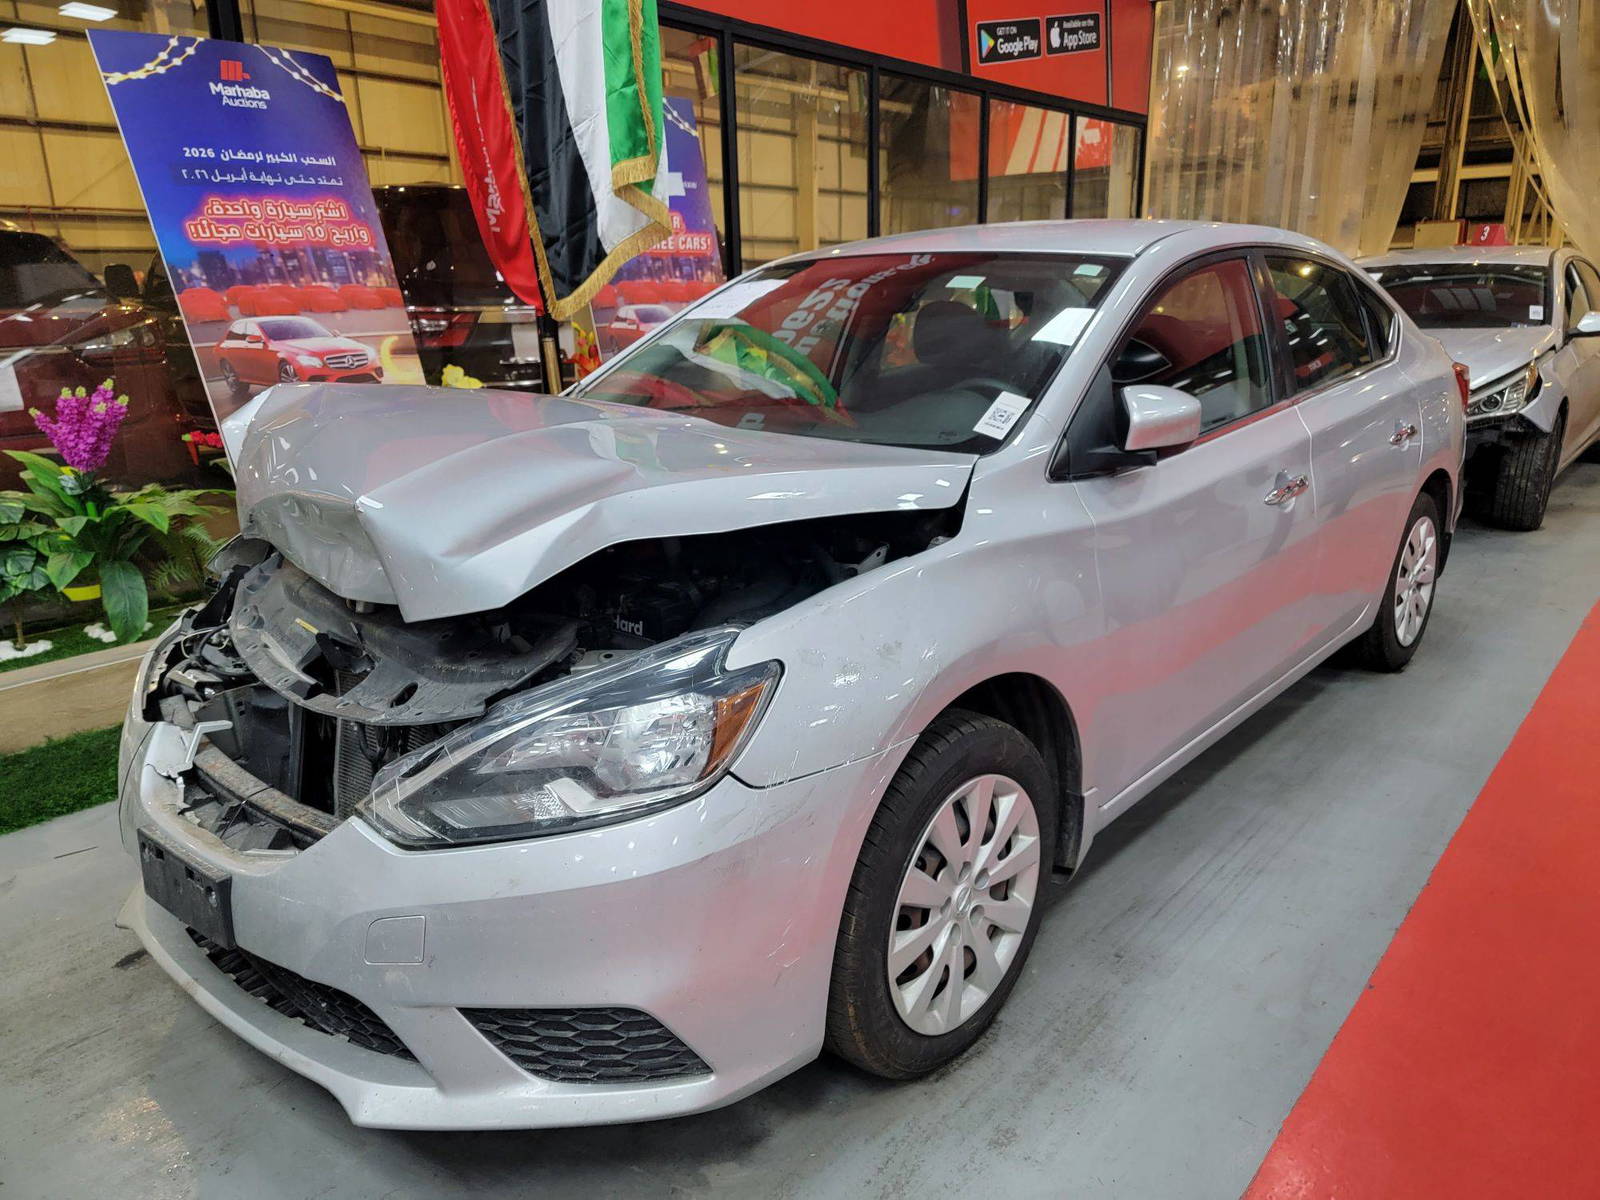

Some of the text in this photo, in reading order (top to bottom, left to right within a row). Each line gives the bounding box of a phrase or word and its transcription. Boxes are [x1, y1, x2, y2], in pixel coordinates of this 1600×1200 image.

[996, 26, 1006, 36] GET
[1010, 26, 1018, 35] ON
[997, 36, 1039, 56] Google Play
[1063, 30, 1097, 50] App Store
[208, 81, 271, 100] Marhaba
[222, 95, 268, 110] Auctions
[182, 147, 337, 167] السحب الكبير لرمضان 2026
[250, 170, 282, 187] نهاية
[284, 174, 316, 186] حتى
[266, 201, 313, 219] سيارة
[246, 222, 303, 241] سيارات
[306, 225, 325, 238] 10
[331, 226, 369, 243] واربح
[1480, 225, 1490, 241] 3
[678, 236, 711, 250] CARS!
